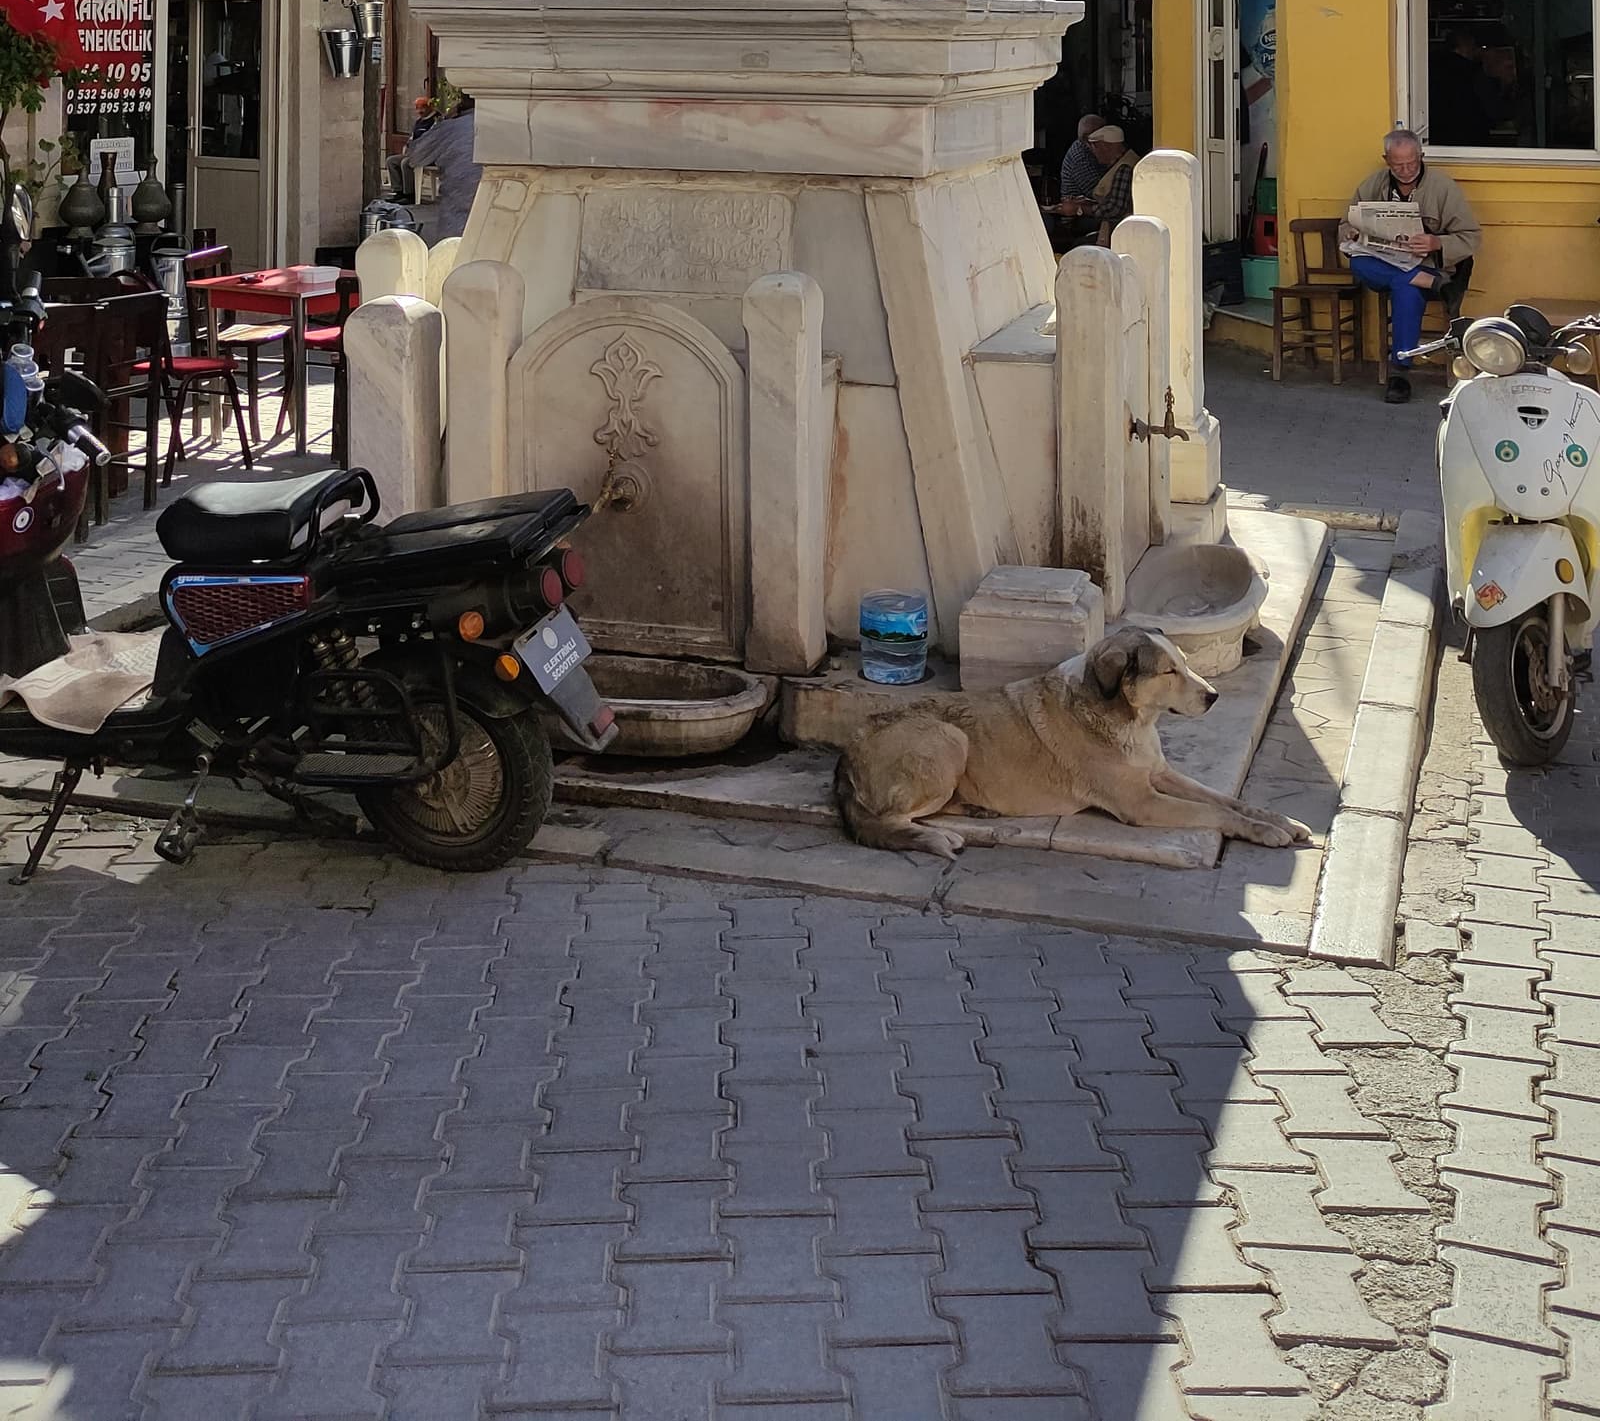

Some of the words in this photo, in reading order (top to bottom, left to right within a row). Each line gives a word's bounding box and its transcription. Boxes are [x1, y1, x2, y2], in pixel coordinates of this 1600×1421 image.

[130, 62, 152, 83] 95
[67, 88, 75, 100] 0
[77, 88, 97, 100] 532
[100, 87, 120, 100] 568
[123, 87, 136, 99] 94
[138, 87, 152, 99] 94
[66, 103, 74, 115] 0
[76, 102, 97, 115] 537
[99, 101, 120, 114] 895
[122, 101, 135, 113] 23
[137, 101, 152, 113] 84
[551, 650, 580, 681] SCOOTER
